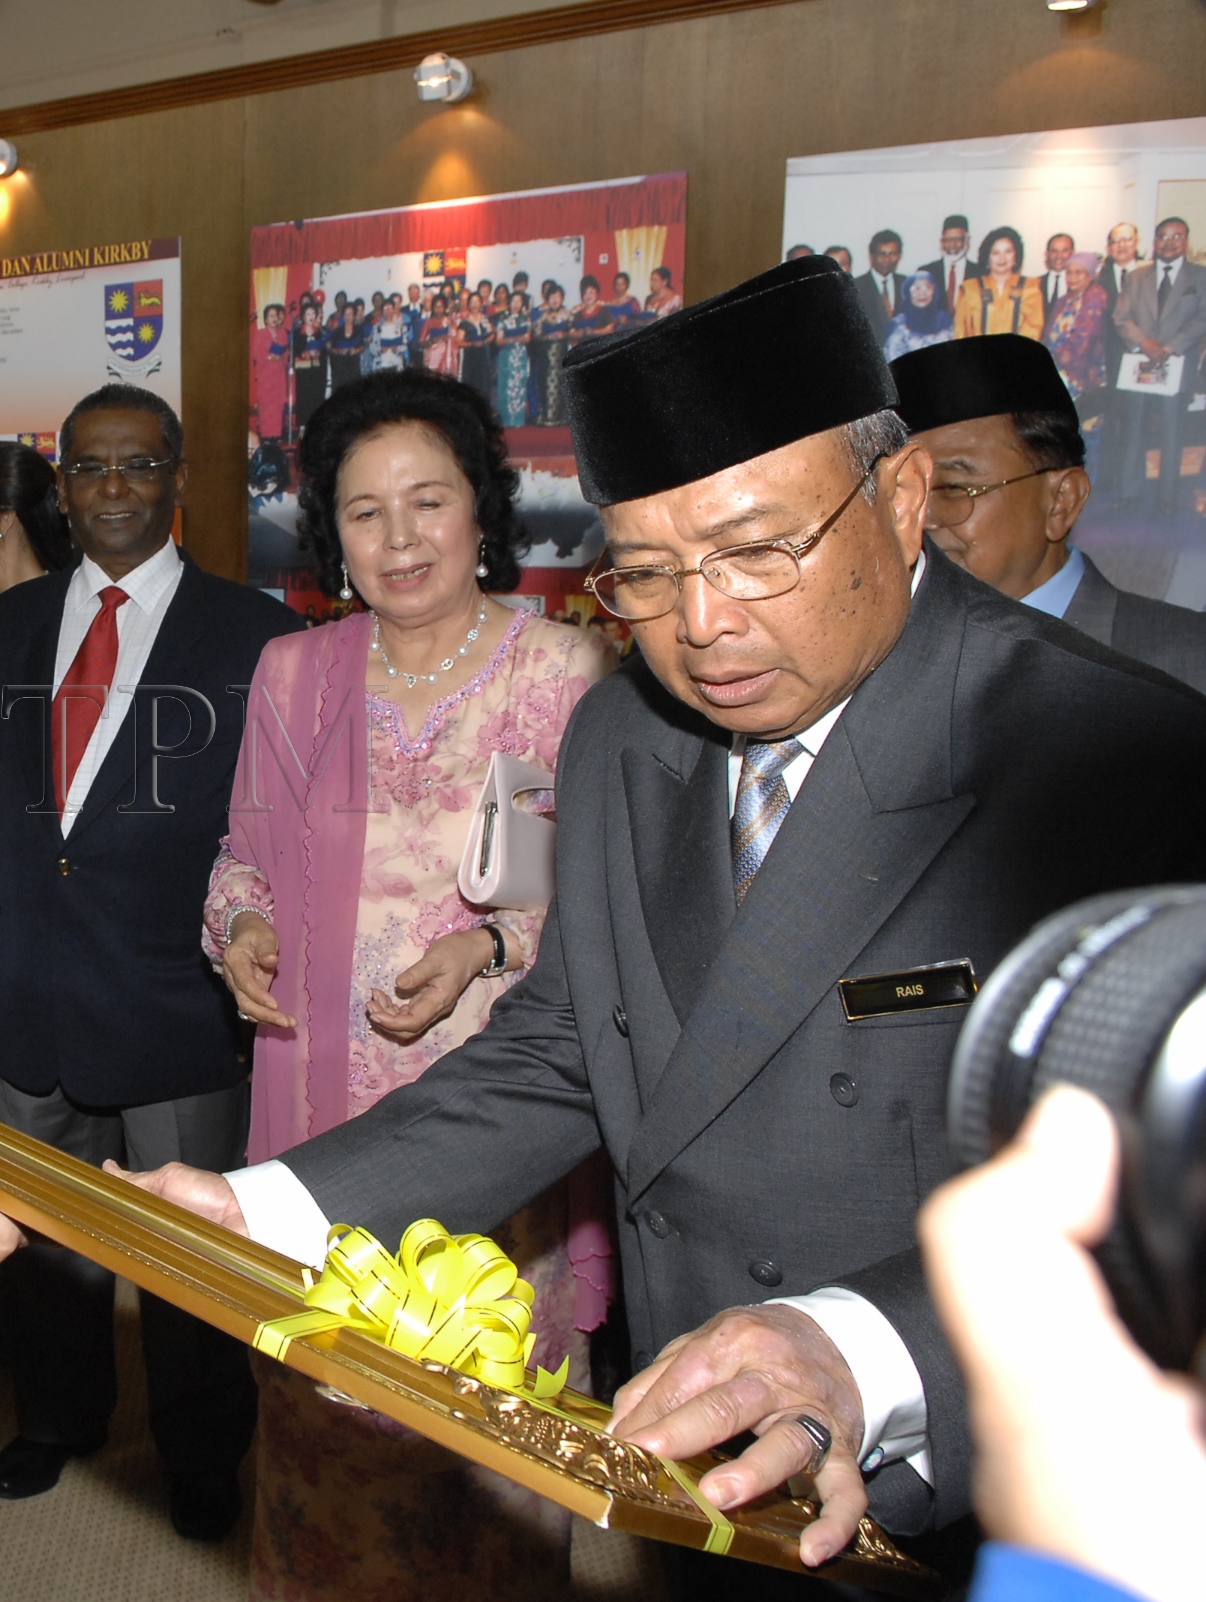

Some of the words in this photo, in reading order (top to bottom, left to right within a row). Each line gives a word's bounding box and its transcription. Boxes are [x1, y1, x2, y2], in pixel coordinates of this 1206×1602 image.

[2, 257, 31, 277] DAN
[32, 248, 90, 272] ALUMNI
[92, 240, 152, 265] KIRKBY
[895, 984, 925, 998] RAIS
